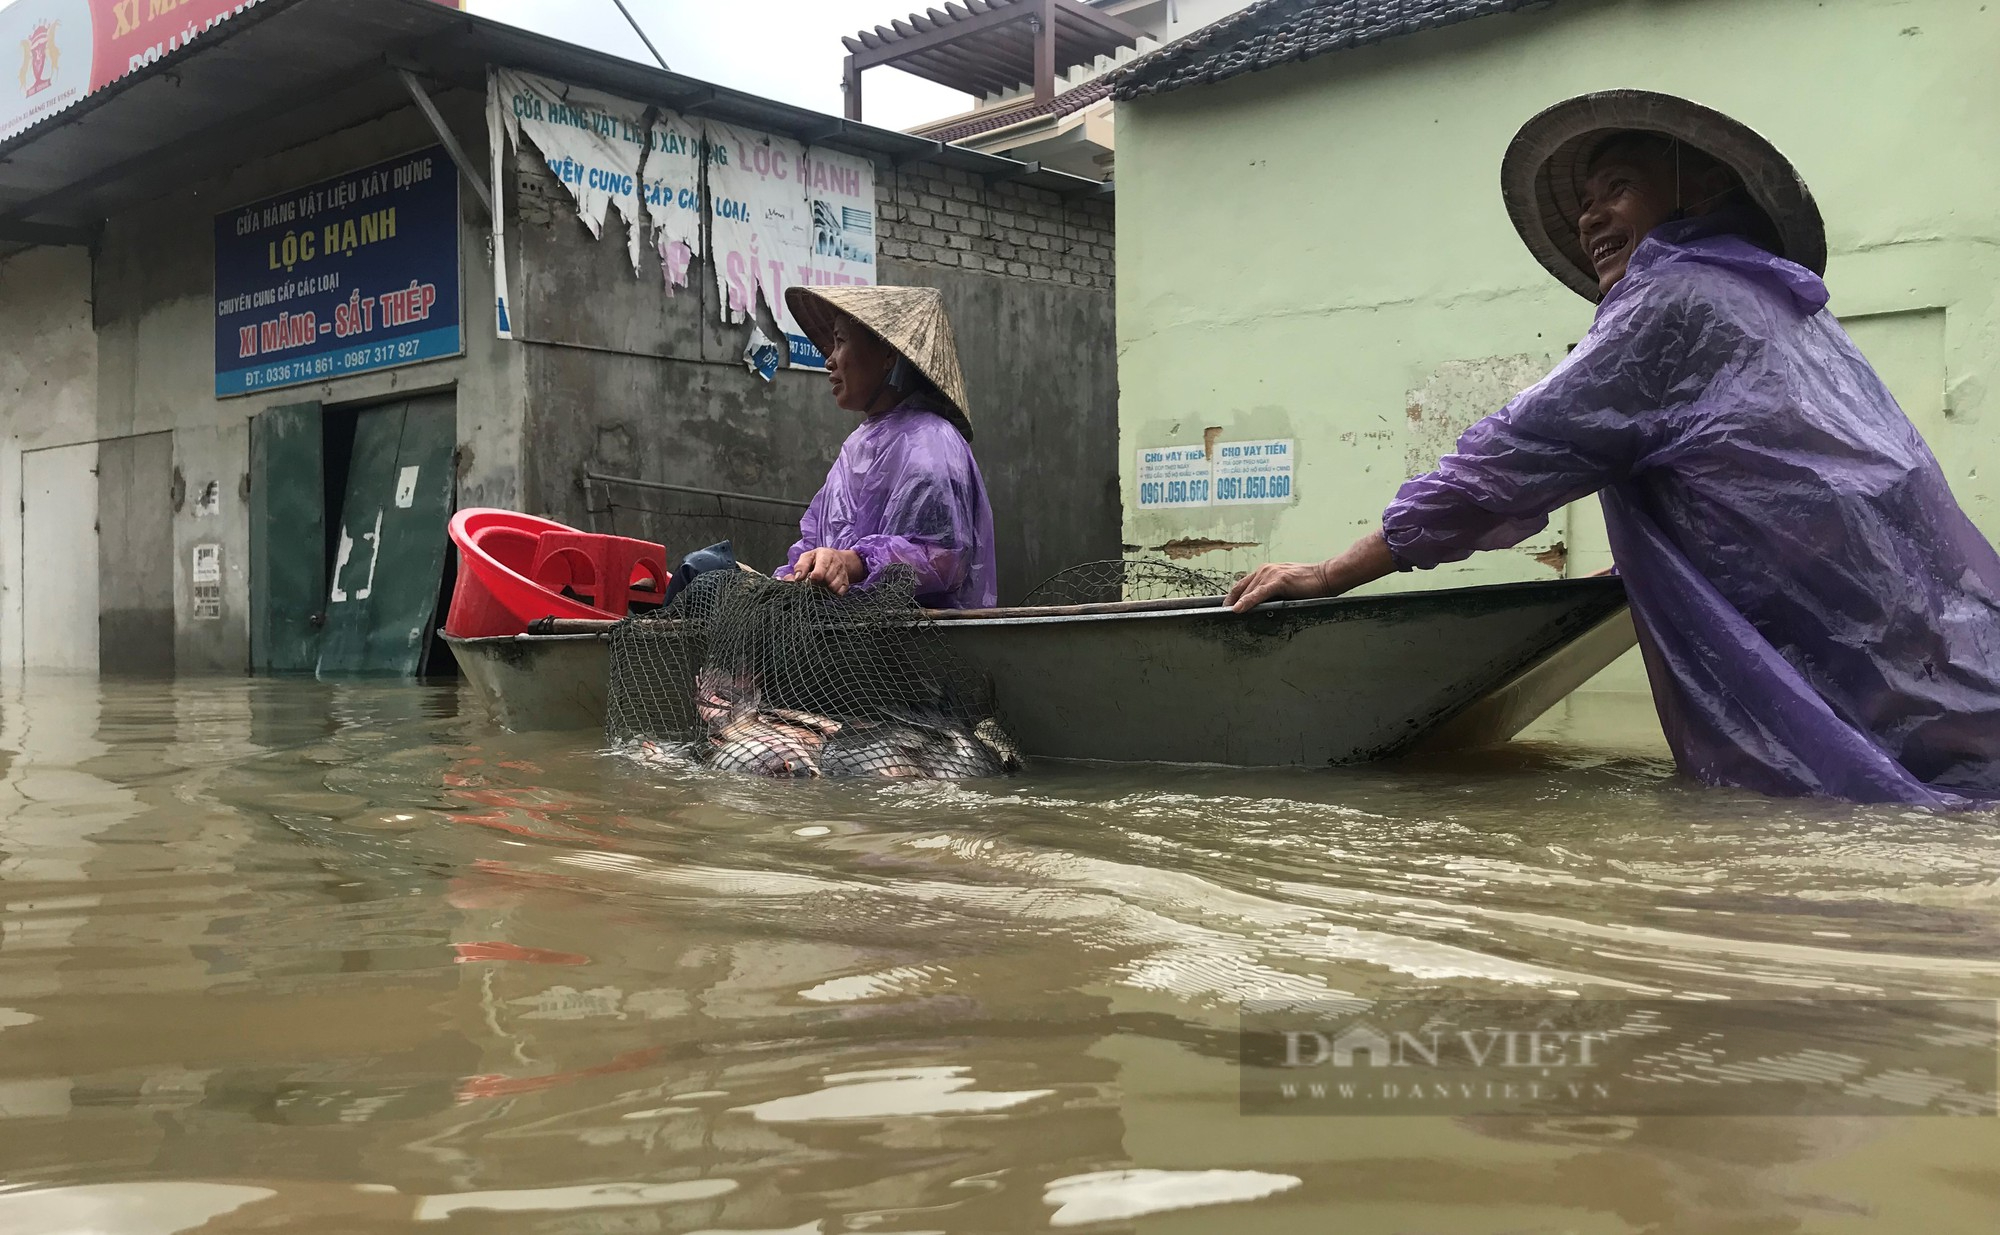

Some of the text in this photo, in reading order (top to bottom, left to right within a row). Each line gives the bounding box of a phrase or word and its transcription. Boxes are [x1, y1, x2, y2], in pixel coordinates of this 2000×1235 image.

[592, 109, 618, 140] VẬT
[660, 129, 686, 155] XÂY
[263, 201, 296, 228] HÀNG
[299, 190, 323, 219] VẬT
[328, 181, 356, 210] LIỆU
[361, 171, 389, 199] XÂY
[394, 157, 432, 191] DỰNG
[589, 168, 633, 196] CUNG
[638, 178, 673, 207] CẤP
[715, 197, 750, 224] LOẠI:
[796, 154, 860, 198] HẠNH
[269, 206, 397, 272] LỘC HẠNH
[218, 272, 339, 316] CHUYÊN CUNG CẤP CÁC LOẠI
[239, 324, 257, 359] XI
[261, 311, 317, 354] MĂNG
[335, 288, 375, 339] SẮT
[380, 279, 436, 329] THÉP
[266, 366, 291, 383] 0336
[293, 360, 313, 377] 714
[315, 357, 333, 373] 861
[344, 350, 371, 368] 0987
[374, 344, 395, 363] 317
[398, 339, 420, 358] 927
[800, 342, 810, 356] 317
[1145, 452, 1163, 463] CHO
[1165, 450, 1182, 461] VAY
[1222, 447, 1241, 457] CHO
[1243, 445, 1262, 456] VAY
[1217, 475, 1290, 500] 0961.050.660
